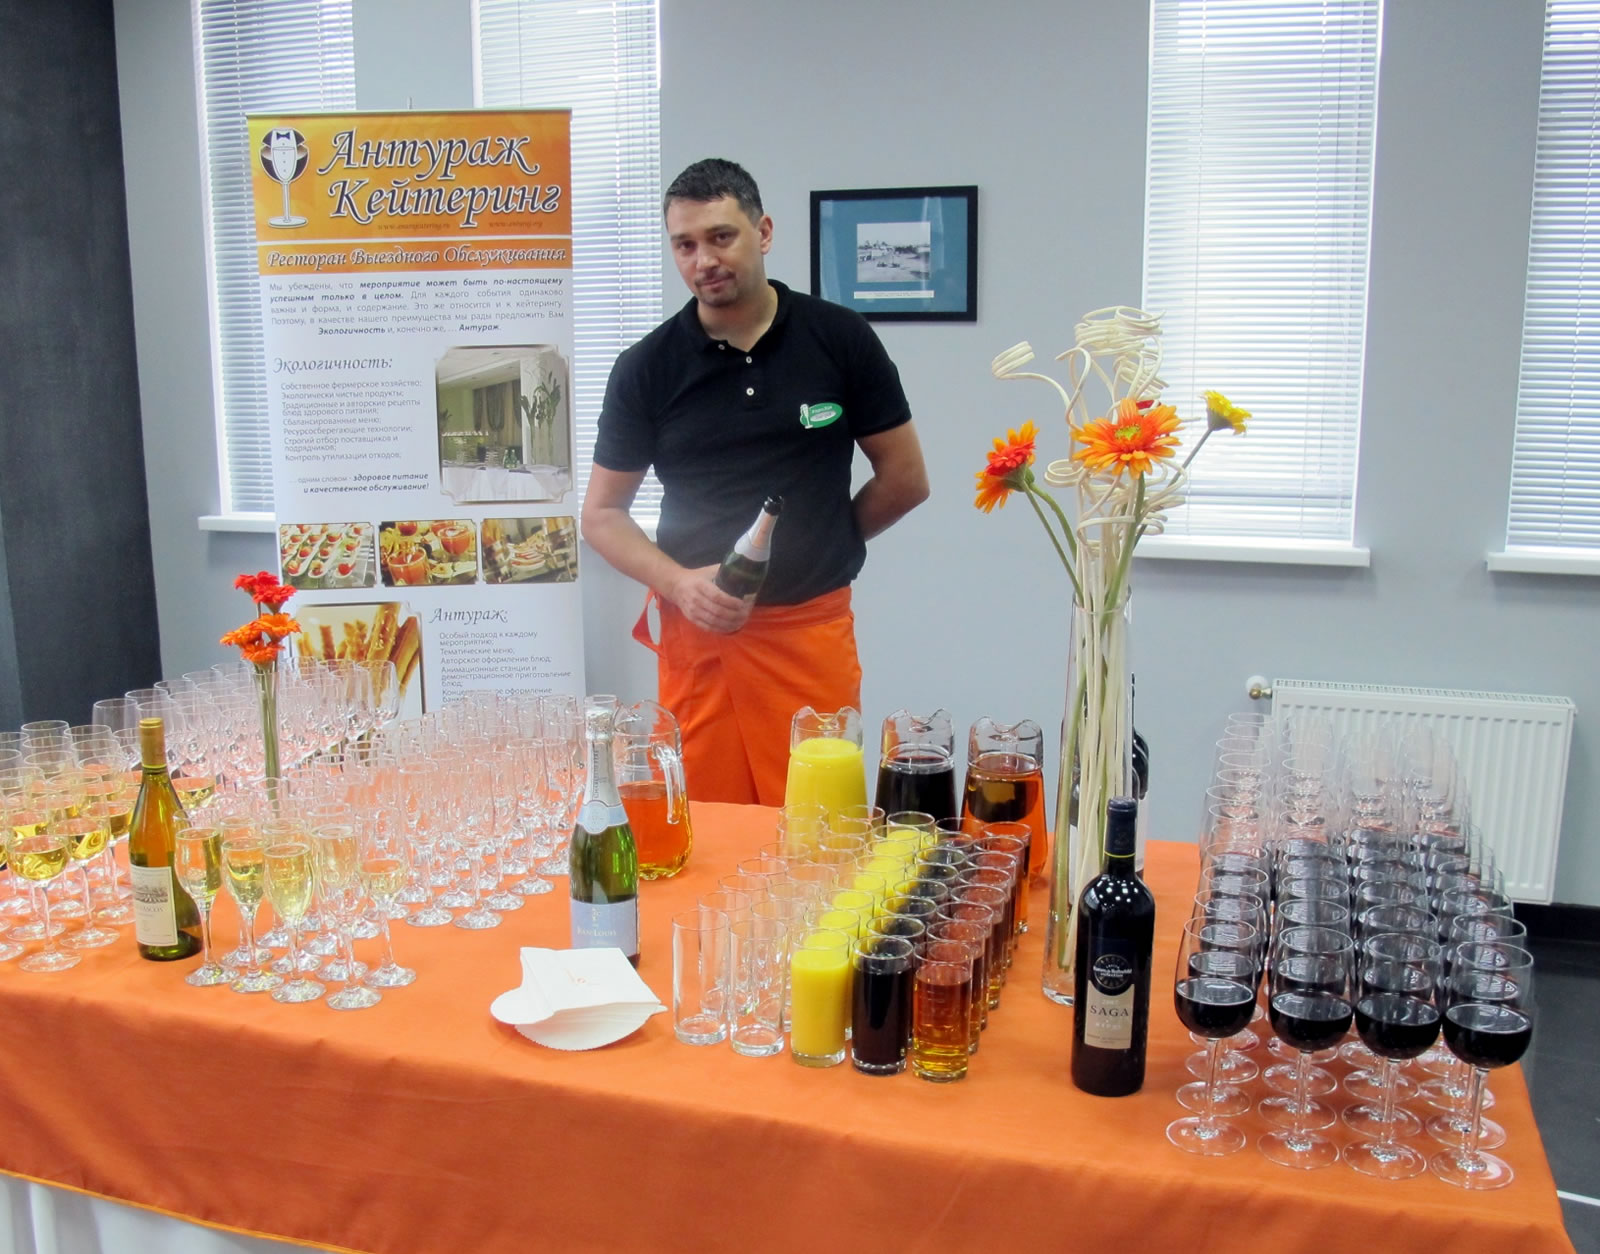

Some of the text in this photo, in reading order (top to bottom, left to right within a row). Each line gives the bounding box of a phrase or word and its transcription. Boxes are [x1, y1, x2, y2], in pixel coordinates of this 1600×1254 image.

[317, 127, 540, 181] Антураж
[328, 175, 560, 228] Кейтеринг
[267, 244, 566, 270] Ресторан Выездного Обслуживания
[288, 283, 332, 291] убеждены,
[360, 281, 421, 290] мероприятие
[426, 280, 458, 288] может
[463, 278, 488, 286] быть
[494, 278, 564, 287] по-настоящему
[270, 295, 314, 304] успешным
[374, 293, 404, 301] целом.
[411, 290, 426, 299] Для
[434, 291, 469, 299] каждого
[477, 288, 511, 297] события
[519, 288, 564, 297] одинаково
[271, 306, 296, 314] важны
[312, 305, 342, 314] форма,
[415, 302, 429, 310] Это
[450, 301, 491, 309] относится
[271, 317, 306, 326] Поэтому,
[358, 315, 388, 323] нашего
[392, 313, 452, 323] преимущества
[471, 312, 492, 321] рады
[496, 311, 545, 320] предложить
[548, 310, 564, 318] Вам
[318, 326, 386, 336] Экологичность
[272, 357, 392, 374] Экологичность:
[281, 380, 422, 391] Собственное фермерское хозяйство;
[282, 391, 334, 400] Экологически
[364, 390, 404, 399] продукты;
[282, 400, 338, 410] Традиционные
[346, 400, 386, 409] авторские
[388, 399, 421, 408] рецепты
[282, 409, 302, 417] блюд
[304, 408, 344, 418] здорового
[283, 426, 366, 436] Ресурсосберегающие
[284, 437, 314, 446] Строгий
[316, 436, 339, 444] отбор
[340, 436, 392, 444] поставщиков
[284, 444, 336, 454] подрядчиков;
[285, 454, 321, 463] Контроль
[322, 453, 367, 462] утилизации
[353, 474, 391, 483] здоровое
[392, 473, 429, 481] питание
[310, 486, 368, 494] качественное
[369, 482, 429, 493] обслуживание!
[440, 632, 469, 640] Особый
[440, 648, 492, 656] Тематические
[482, 656, 529, 664] оформление
[441, 666, 499, 674] Анимационные
[441, 672, 572, 682] демонстрационное приготовление
[442, 680, 464, 688] блюд;
[505, 688, 552, 696] оформление
[1090, 1005, 1129, 1017] SAGA
